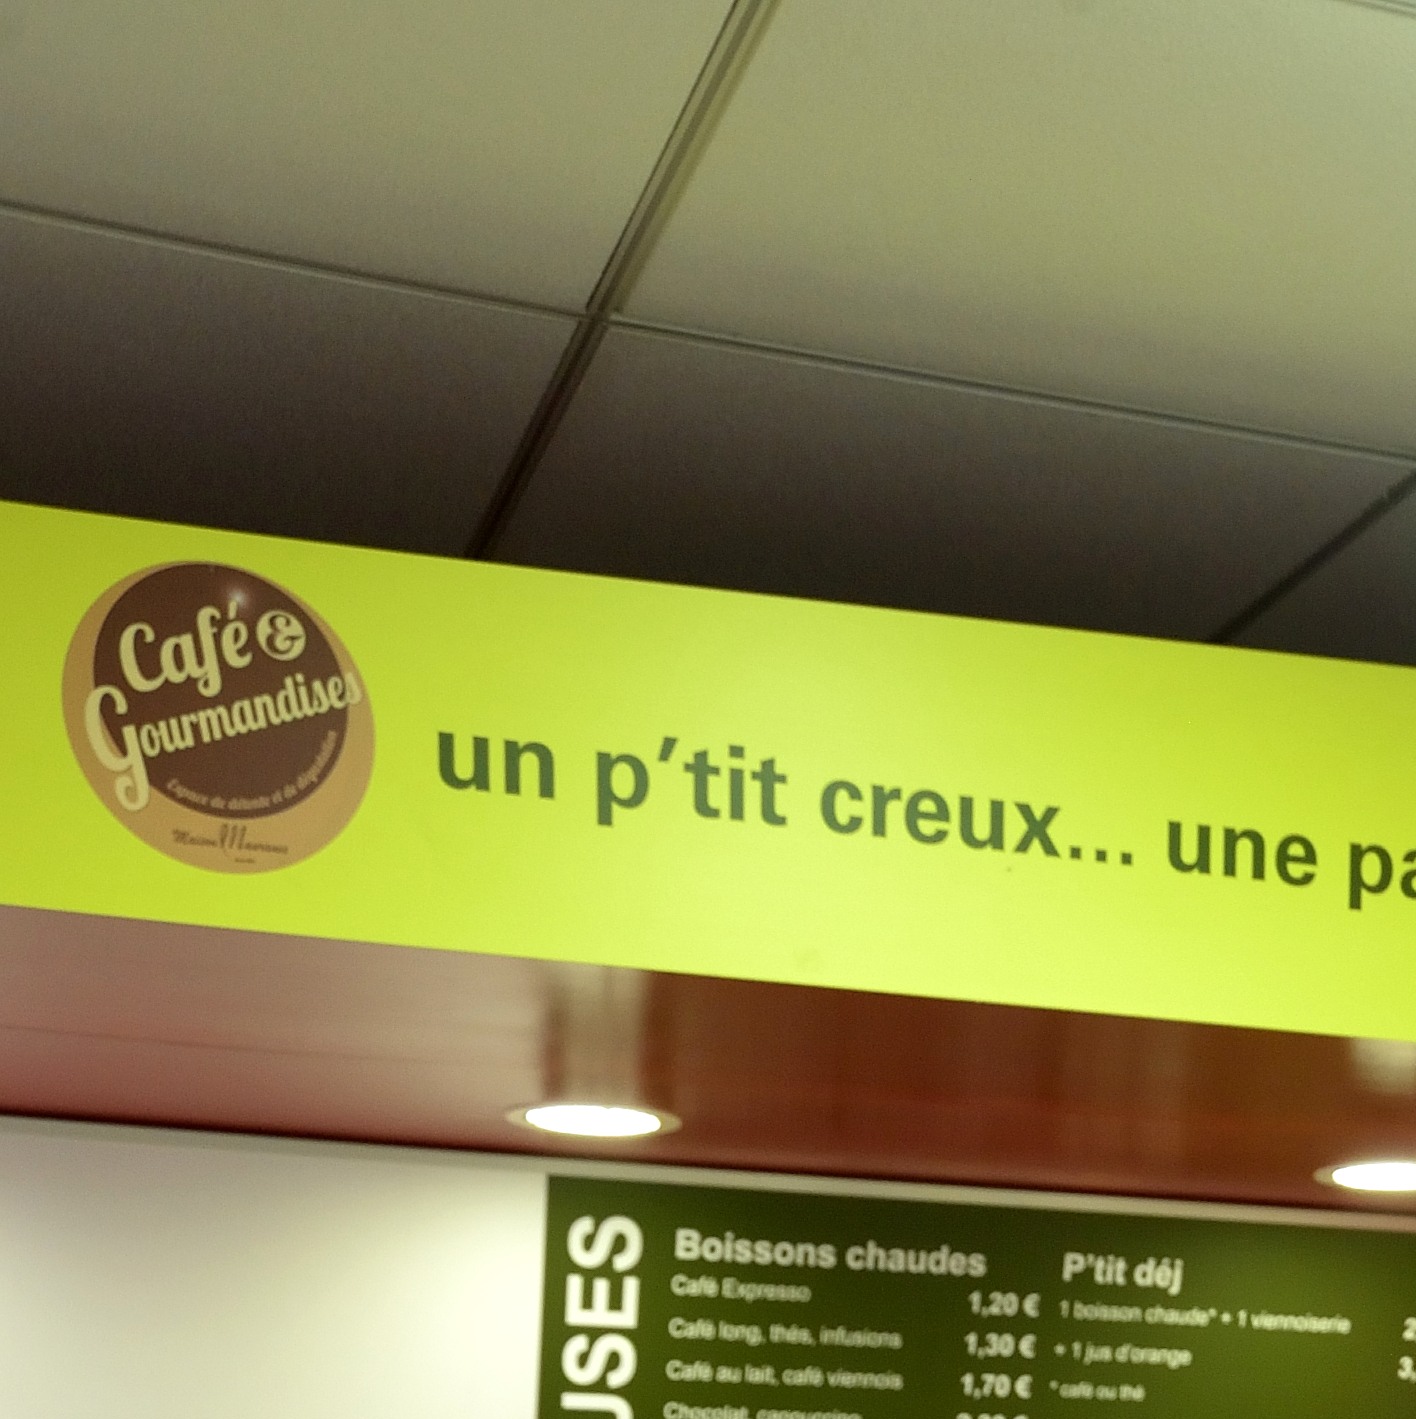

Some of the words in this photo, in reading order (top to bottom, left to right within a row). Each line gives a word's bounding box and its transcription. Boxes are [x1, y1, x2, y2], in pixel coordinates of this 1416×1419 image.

[119, 600, 253, 697] Café
[85, 672, 363, 812] Gourmandises
[437, 730, 555, 800] un
[595, 735, 788, 828] p'tit
[1167, 820, 1318, 887] une
[674, 1227, 837, 1269] Boissons
[845, 1240, 987, 1278] chaudes
[1062, 1252, 1128, 1286] P'tit
[1133, 1257, 1184, 1296] déj
[969, 1290, 1020, 1317] 1,20
[1022, 1293, 1040, 1318] €
[964, 1332, 1016, 1358] 1,30
[1018, 1333, 1036, 1359] €
[960, 1372, 1012, 1399] 1,70
[1014, 1374, 1033, 1399] €
